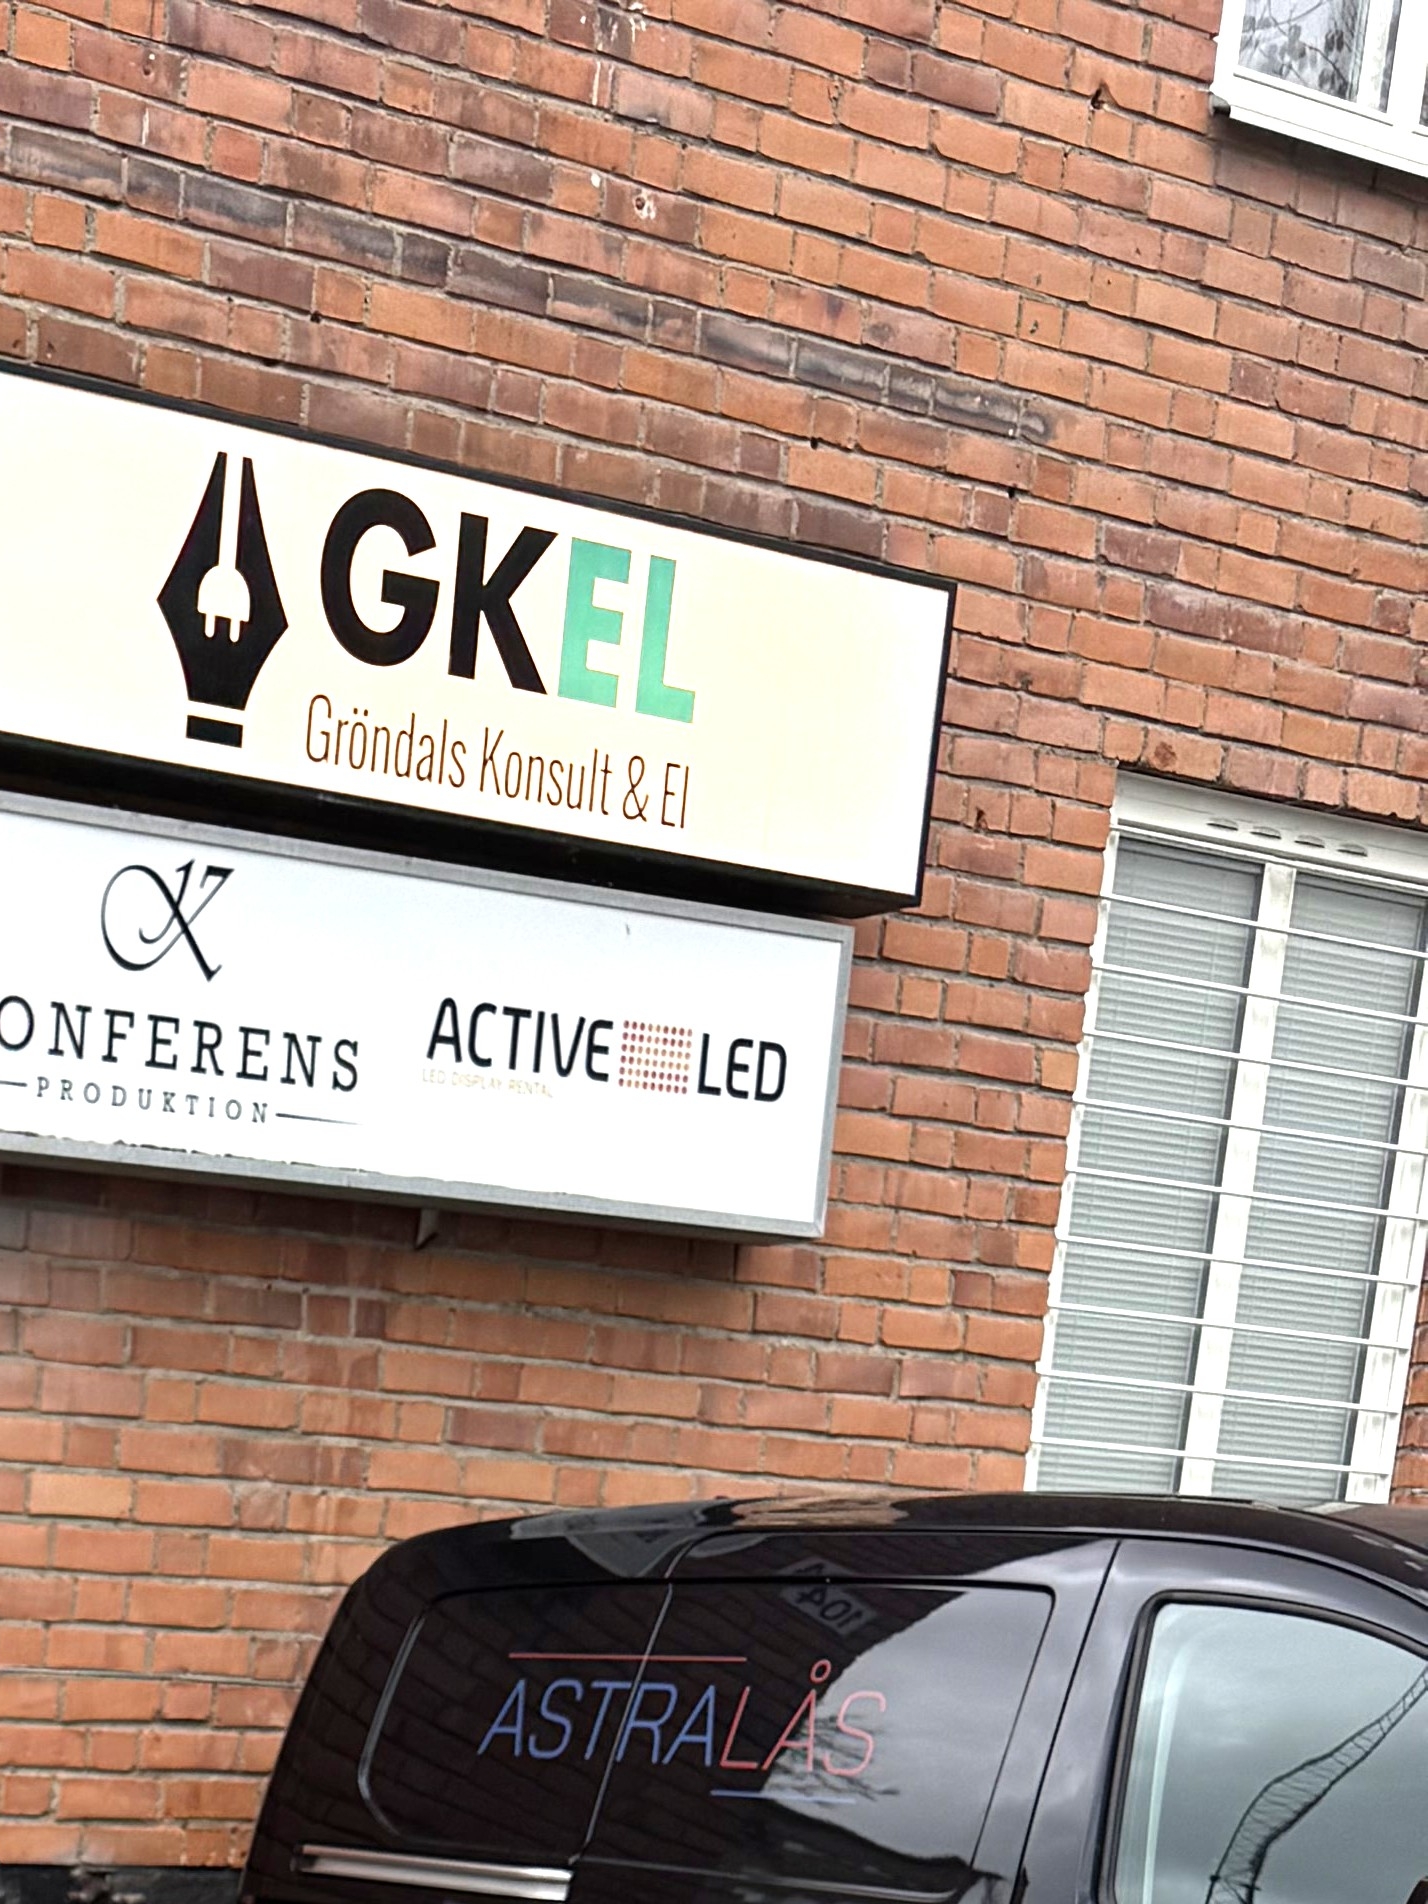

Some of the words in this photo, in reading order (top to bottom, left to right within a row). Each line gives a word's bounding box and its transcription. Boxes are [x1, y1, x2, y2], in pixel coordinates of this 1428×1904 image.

[320, 487, 695, 724] GKEL
[305, 694, 467, 789] Gröndals
[479, 726, 613, 815] Konsult
[622, 755, 649, 822] &
[660, 762, 690, 829] El
[37, 1076, 268, 1123] PRODUKTION
[426, 997, 614, 1083] ACTIVE
[697, 1032, 787, 1102] LED
[476, 1659, 887, 1778] ASTRALÅS
